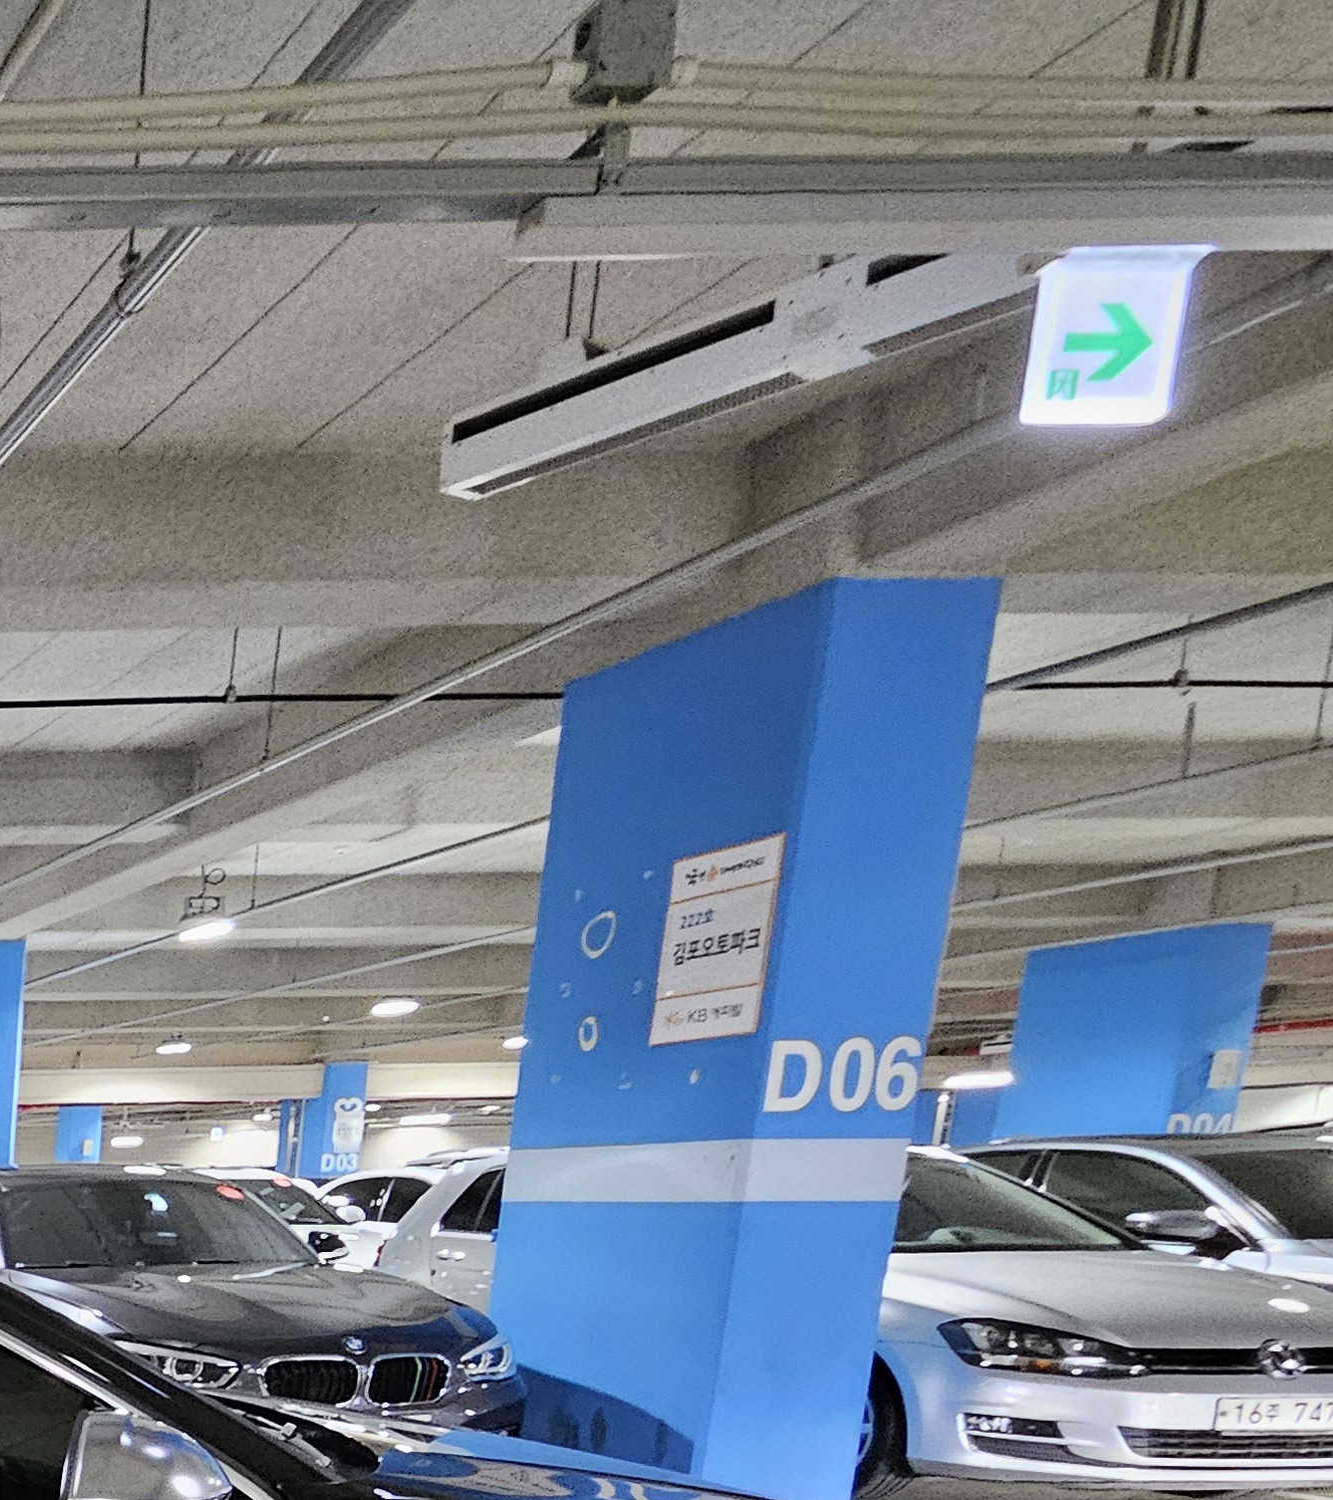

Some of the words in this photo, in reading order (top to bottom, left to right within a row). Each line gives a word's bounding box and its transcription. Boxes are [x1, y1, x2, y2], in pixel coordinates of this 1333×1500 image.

[673, 928, 761, 966] 김포오토파크
[763, 1036, 921, 1112] D06
[321, 1153, 359, 1173] D03
